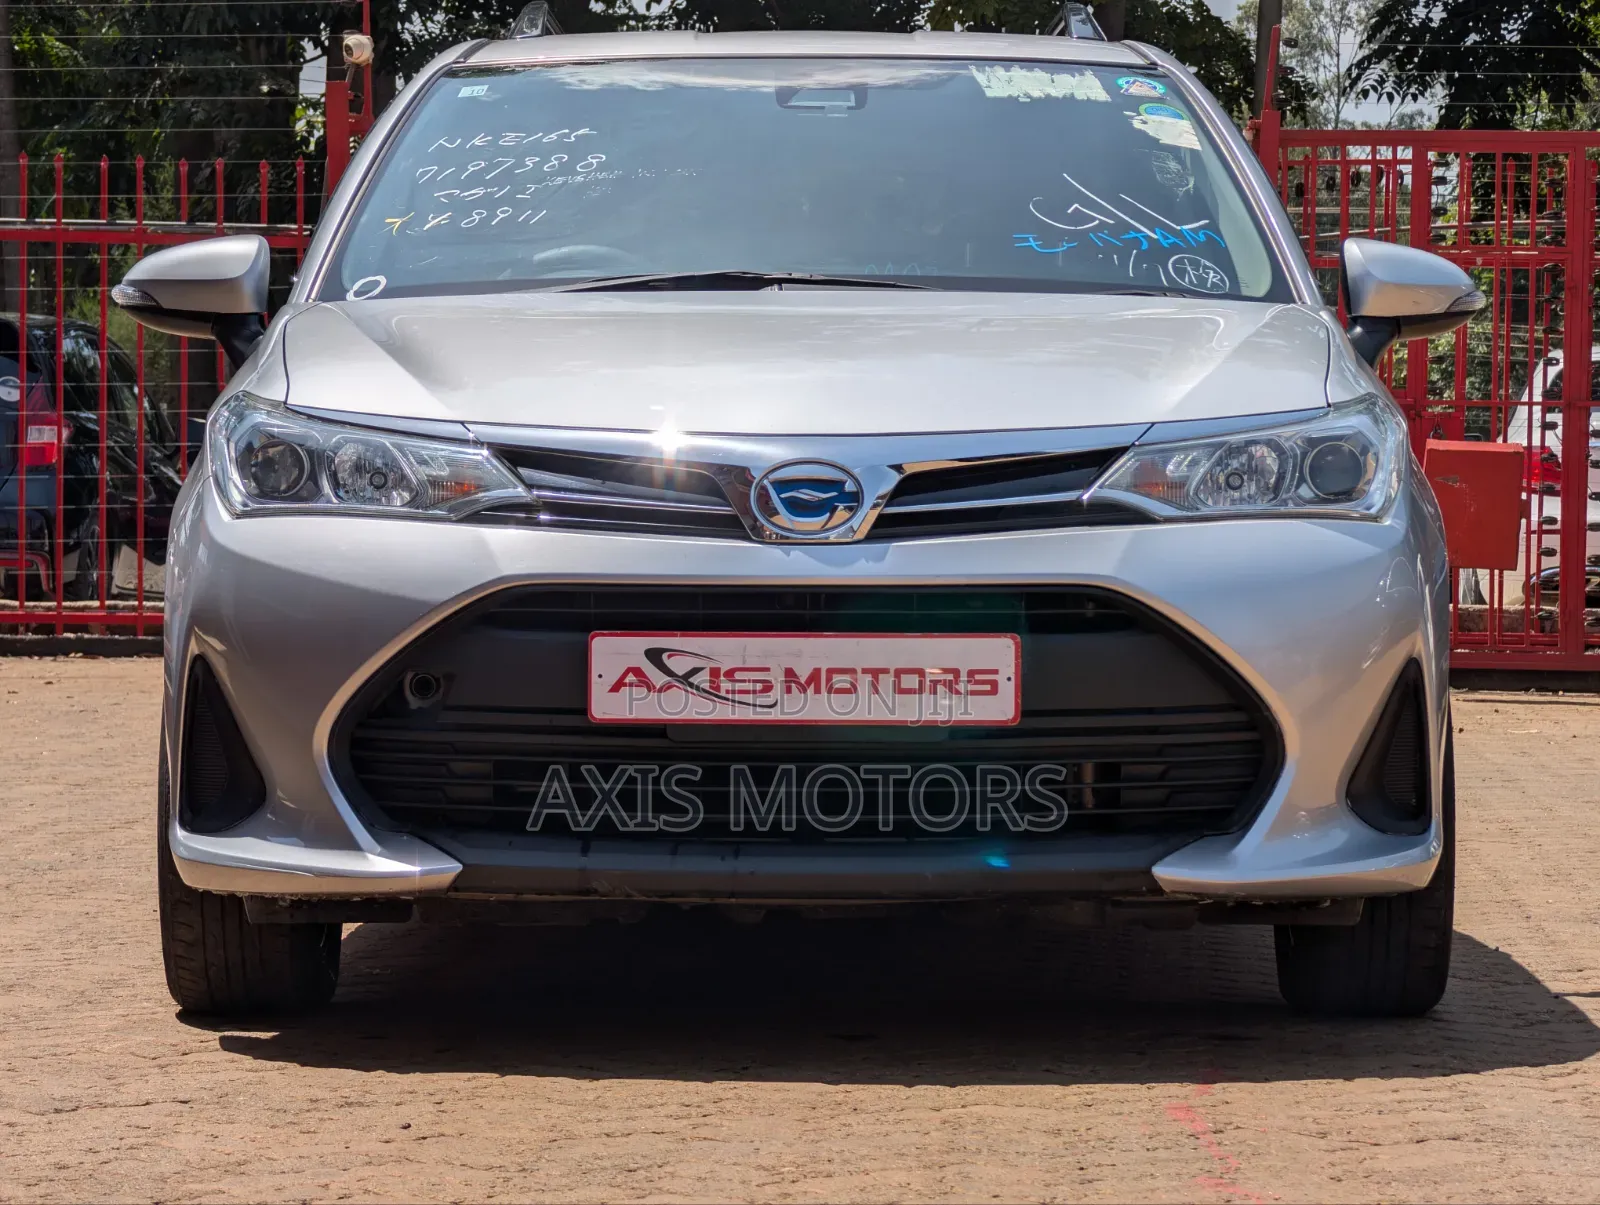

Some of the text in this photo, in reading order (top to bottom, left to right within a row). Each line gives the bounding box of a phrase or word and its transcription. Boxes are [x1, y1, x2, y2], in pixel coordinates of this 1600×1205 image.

[428, 128, 598, 152] NKE165
[607, 660, 999, 702] AXIS MOTORS
